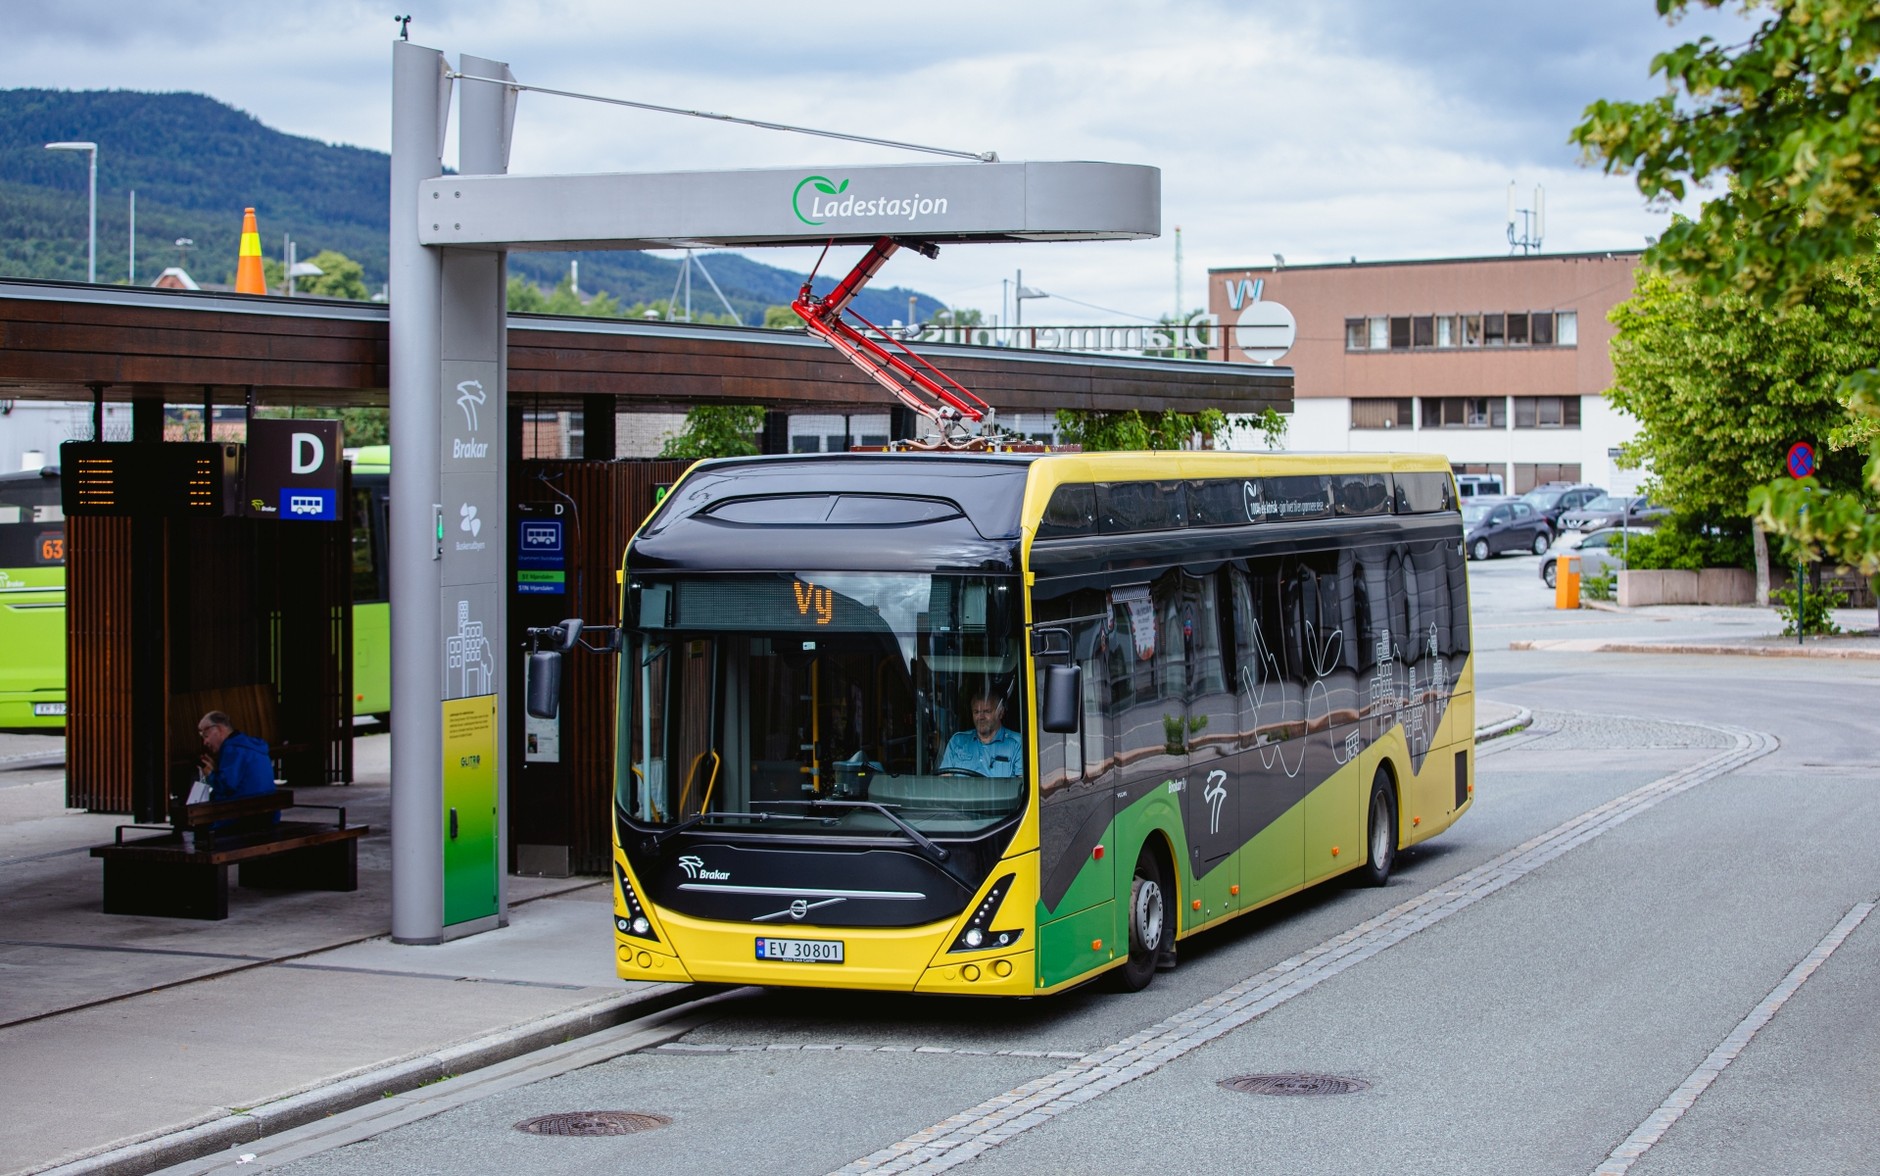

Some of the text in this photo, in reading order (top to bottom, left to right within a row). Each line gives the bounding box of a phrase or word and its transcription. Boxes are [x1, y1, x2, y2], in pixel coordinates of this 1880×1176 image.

[812, 194, 948, 221] Ladestasjon
[291, 432, 324, 475] D
[452, 437, 488, 459] Brakar
[554, 503, 564, 515] D
[42, 539, 63, 560] 63
[793, 582, 832, 624] Vy
[700, 869, 731, 880] Brakar
[770, 941, 838, 959] EV 30801
